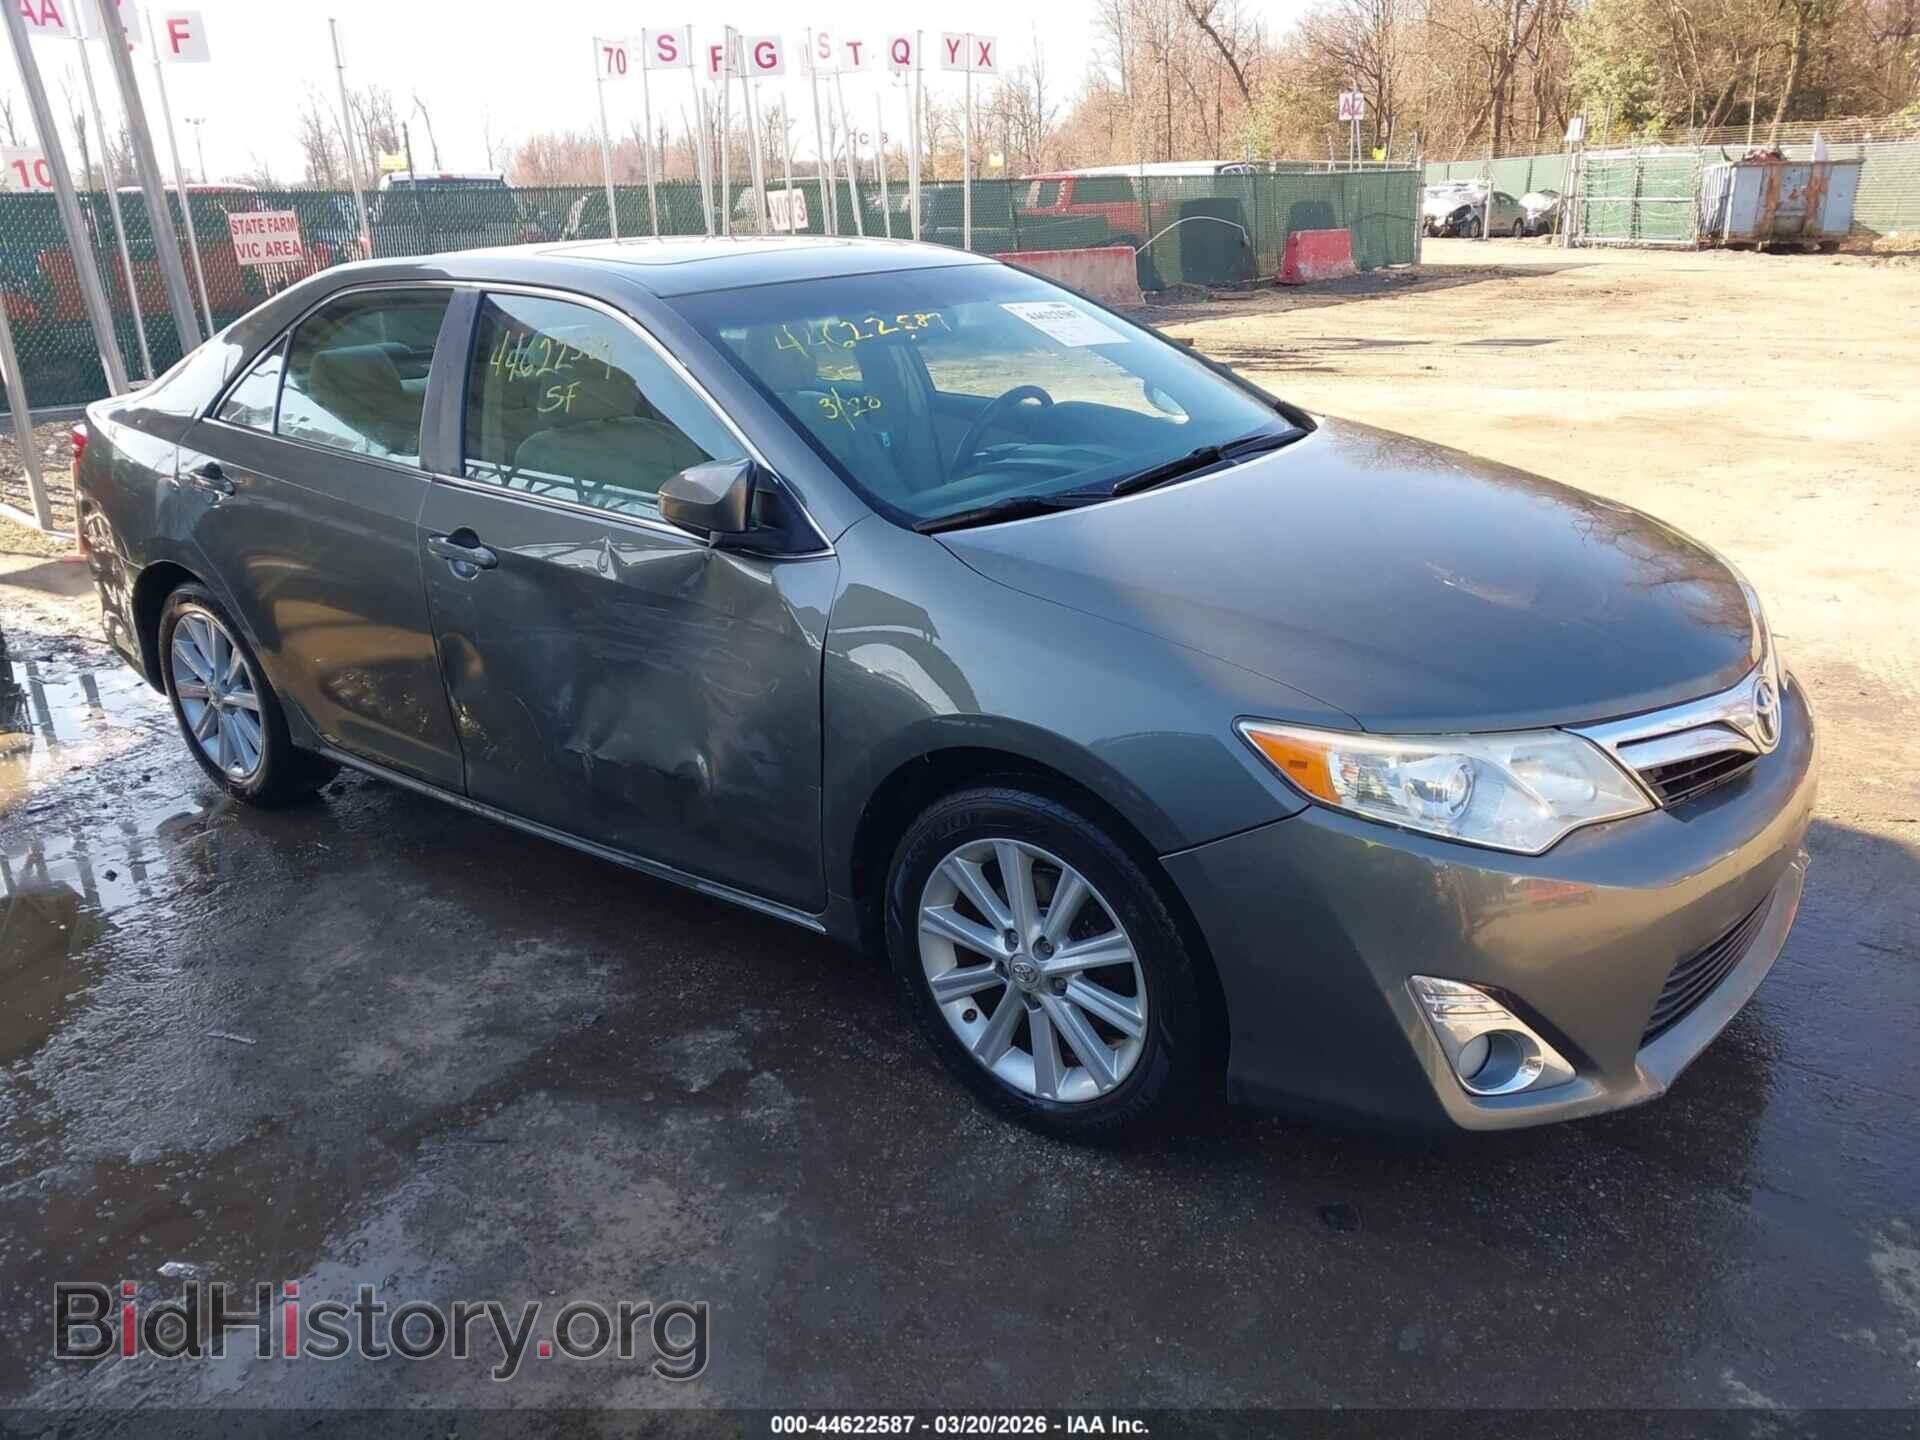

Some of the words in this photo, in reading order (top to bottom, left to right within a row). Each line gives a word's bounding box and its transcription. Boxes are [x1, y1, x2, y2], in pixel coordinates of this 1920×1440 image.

[167, 19, 190, 53] F
[657, 34, 677, 62] S
[818, 32, 831, 59] S
[603, 46, 626, 74] 70
[710, 45, 723, 72] F
[754, 41, 777, 69] G
[846, 41, 862, 65] T
[892, 38, 910, 65] Q
[946, 38, 960, 64] Y
[978, 41, 992, 67] X
[12, 160, 56, 187] 10
[231, 219, 266, 235] STATE
[267, 216, 297, 233] FARM
[236, 243, 261, 258] VIC
[265, 240, 302, 257] AREA
[537, 380, 582, 413] SF
[818, 386, 882, 431] 3/20
